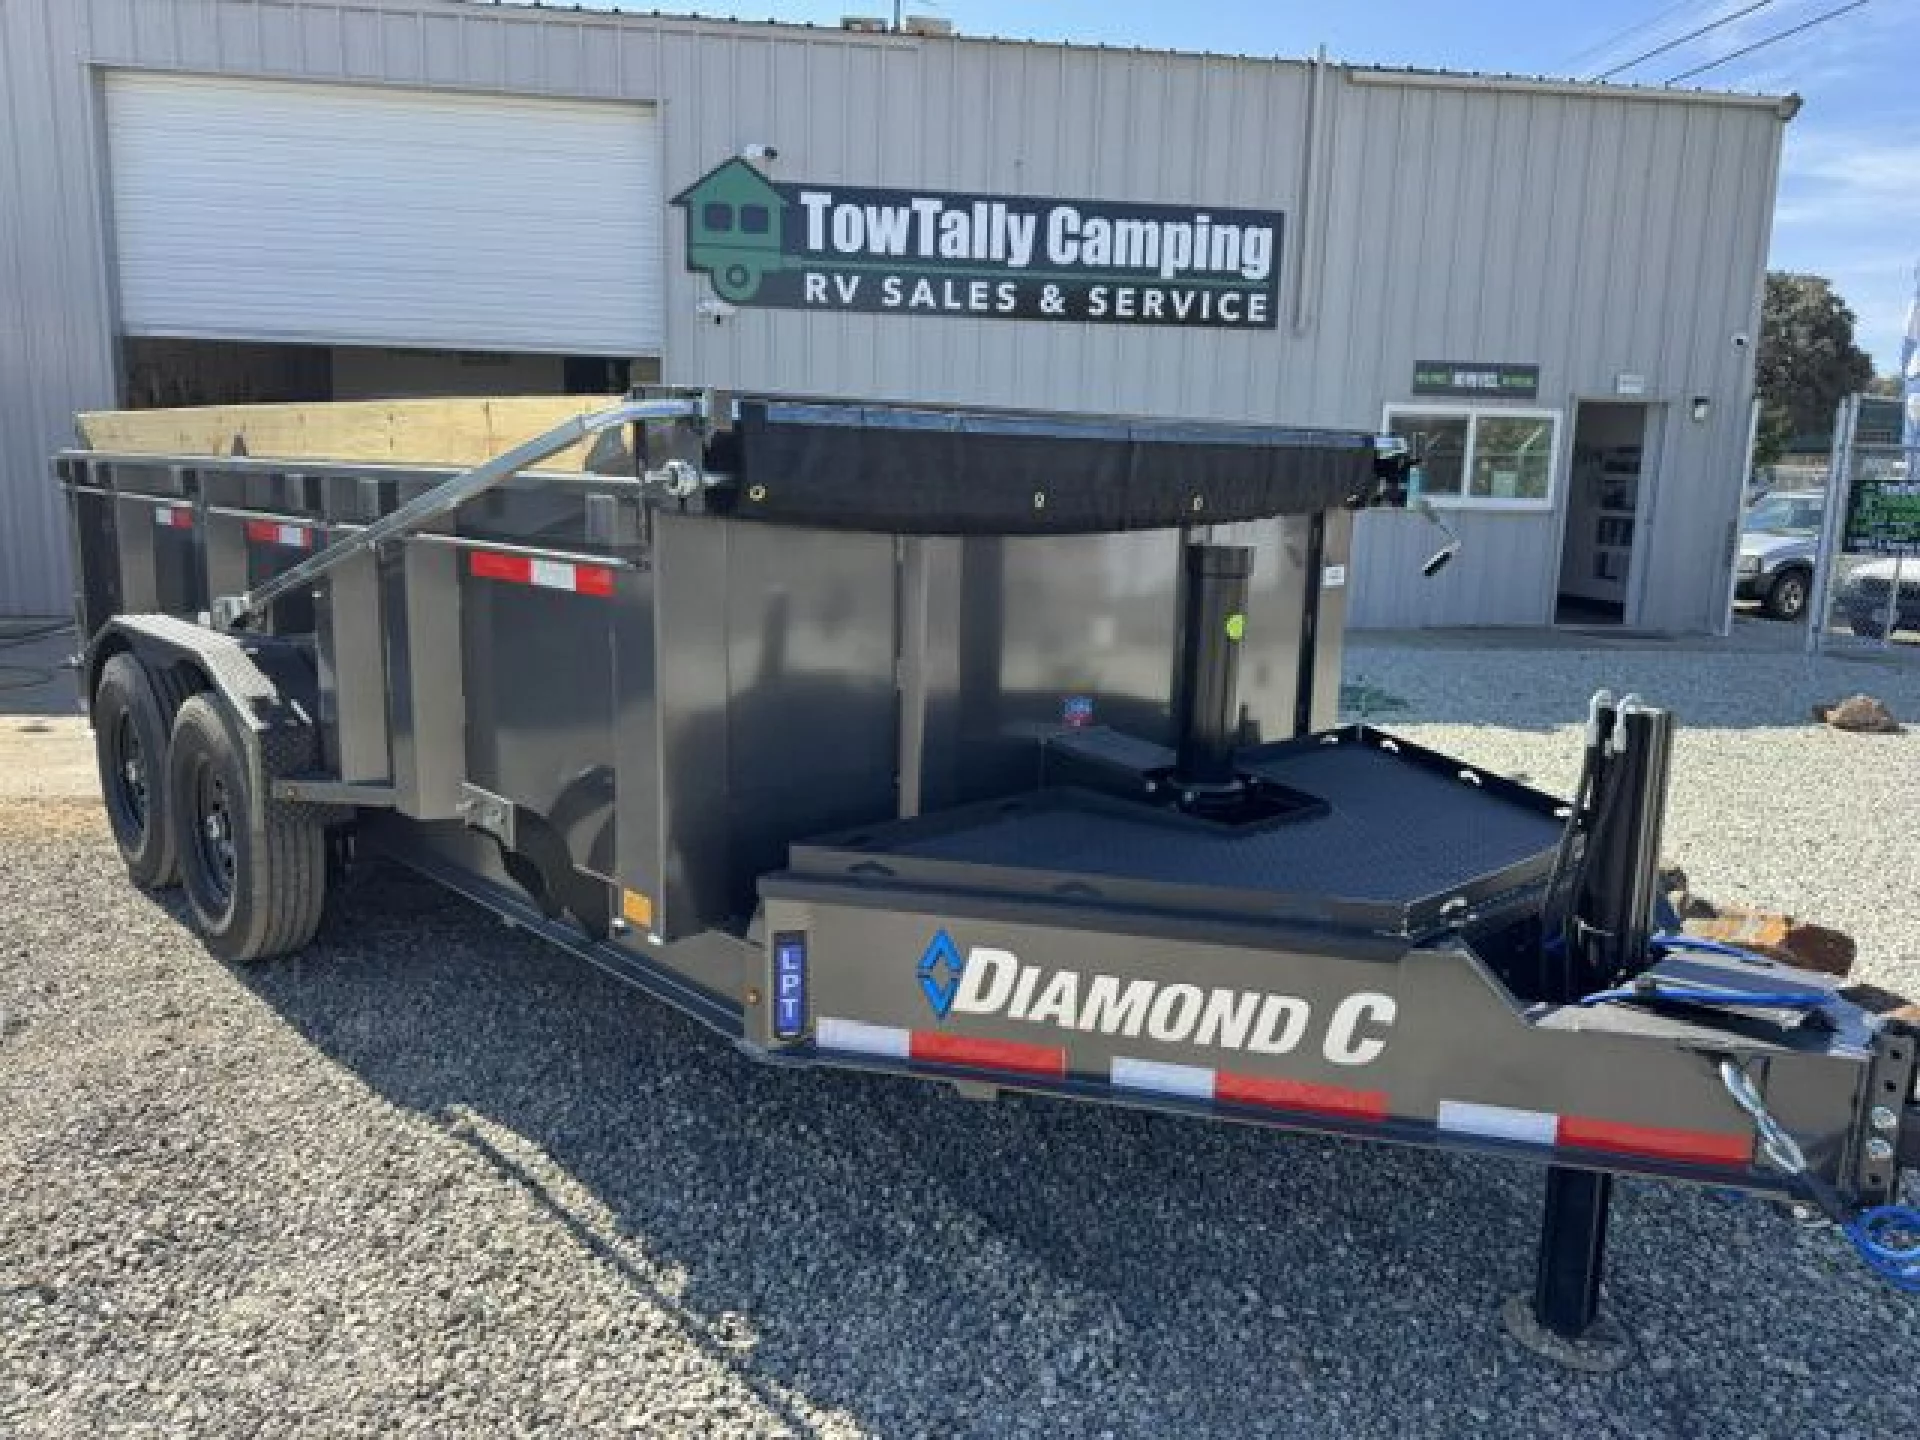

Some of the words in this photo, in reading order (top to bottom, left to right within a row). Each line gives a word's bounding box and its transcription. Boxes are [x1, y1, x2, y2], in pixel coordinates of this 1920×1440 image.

[801, 191, 1035, 268] TowTally
[1047, 206, 1274, 279] Camping
[804, 274, 861, 304] RV
[881, 277, 1017, 312] SALES
[1040, 284, 1066, 315] &
[1088, 288, 1269, 321] SERVICE
[780, 949, 799, 1020] LPT
[952, 946, 1311, 1055] DIAMOND
[1322, 991, 1397, 1066] C
